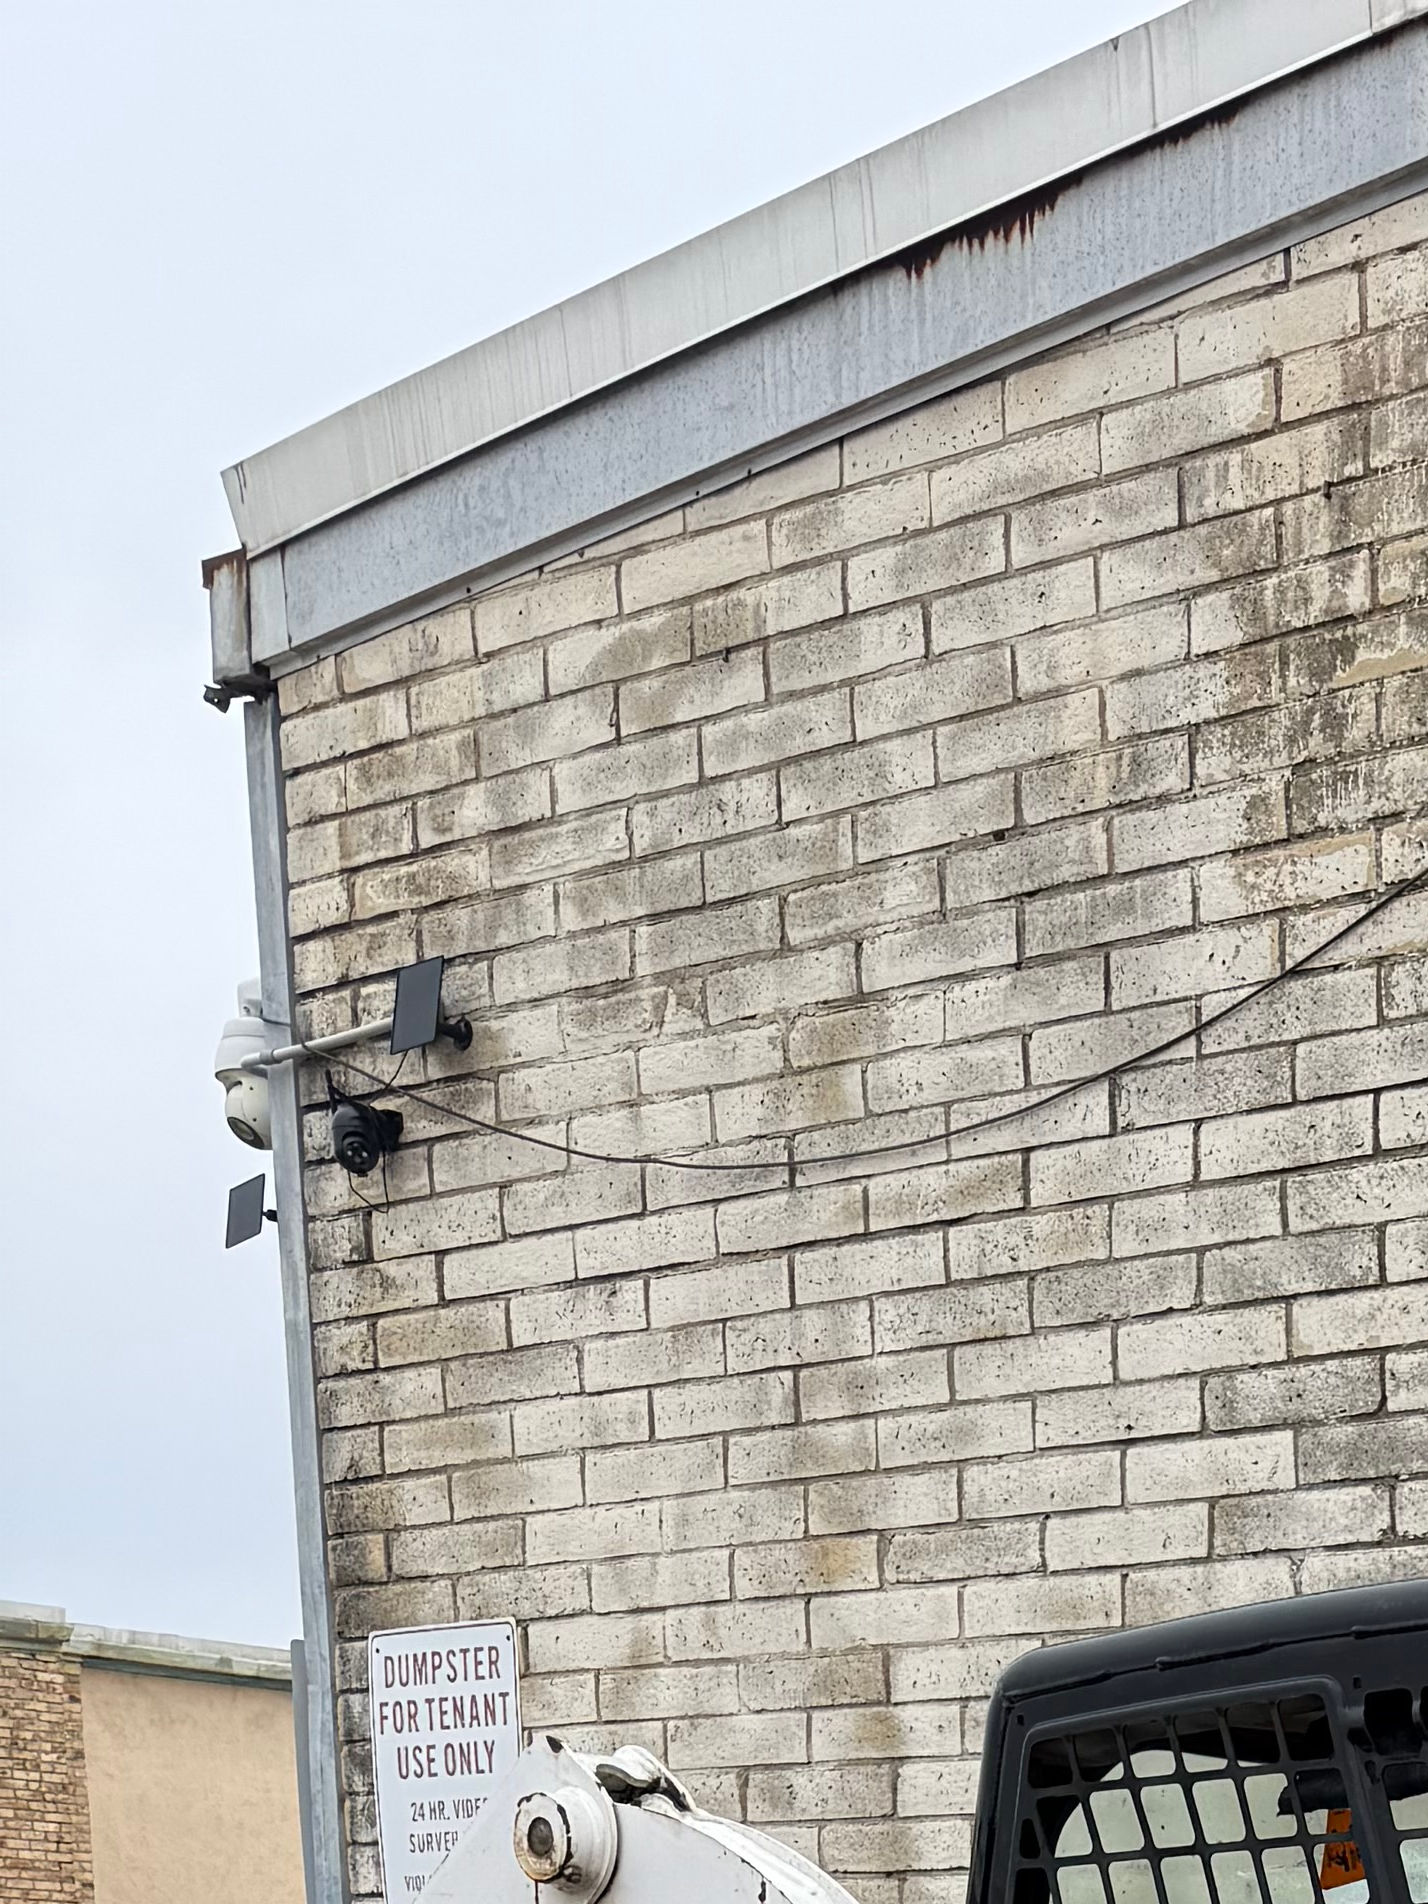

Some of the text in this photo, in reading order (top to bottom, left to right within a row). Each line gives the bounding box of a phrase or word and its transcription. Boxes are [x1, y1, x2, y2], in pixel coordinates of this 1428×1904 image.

[384, 1646, 500, 1688] DUMPSTER
[380, 1692, 509, 1735] FOR TENANT
[397, 1740, 495, 1780] USE ONLY
[411, 1797, 487, 1822] 24 HR. VIDE
